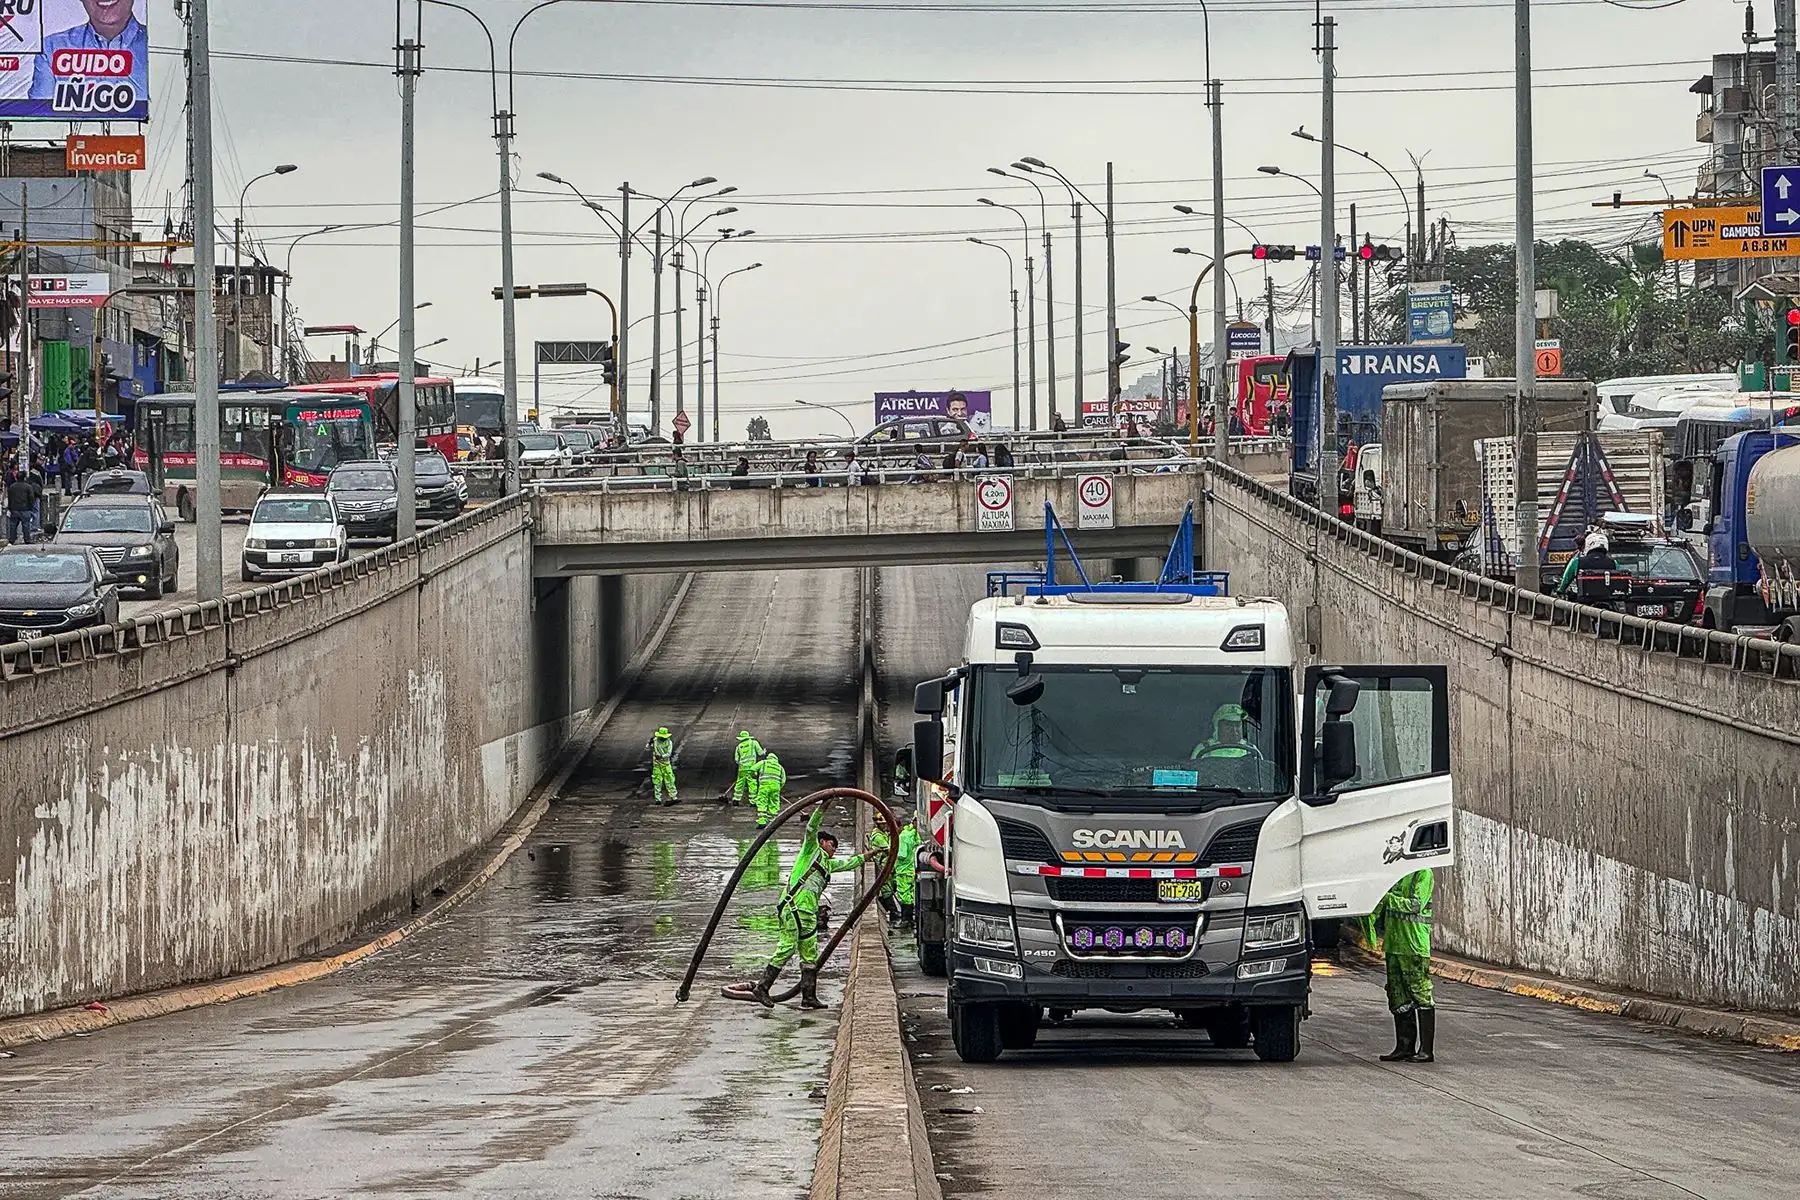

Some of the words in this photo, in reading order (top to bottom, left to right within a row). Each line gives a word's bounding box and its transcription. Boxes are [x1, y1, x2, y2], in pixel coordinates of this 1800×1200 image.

[57, 53, 126, 73] GUIDO
[1692, 220, 1715, 232] UPN
[1722, 225, 1760, 238] CAMPUS
[1742, 242, 1748, 252] A
[1752, 241, 1769, 251] 6.8
[1772, 240, 1787, 251] KM
[1411, 301, 1450, 309] BREVETE
[1365, 355, 1441, 373] RANSA
[881, 397, 939, 410] ATREVIA
[317, 424, 327, 435] A
[1086, 482, 1105, 496] 40
[982, 511, 1010, 520] ALTURA
[1072, 829, 1187, 849] SCANIA
[1159, 885, 1200, 898] BMT-786
